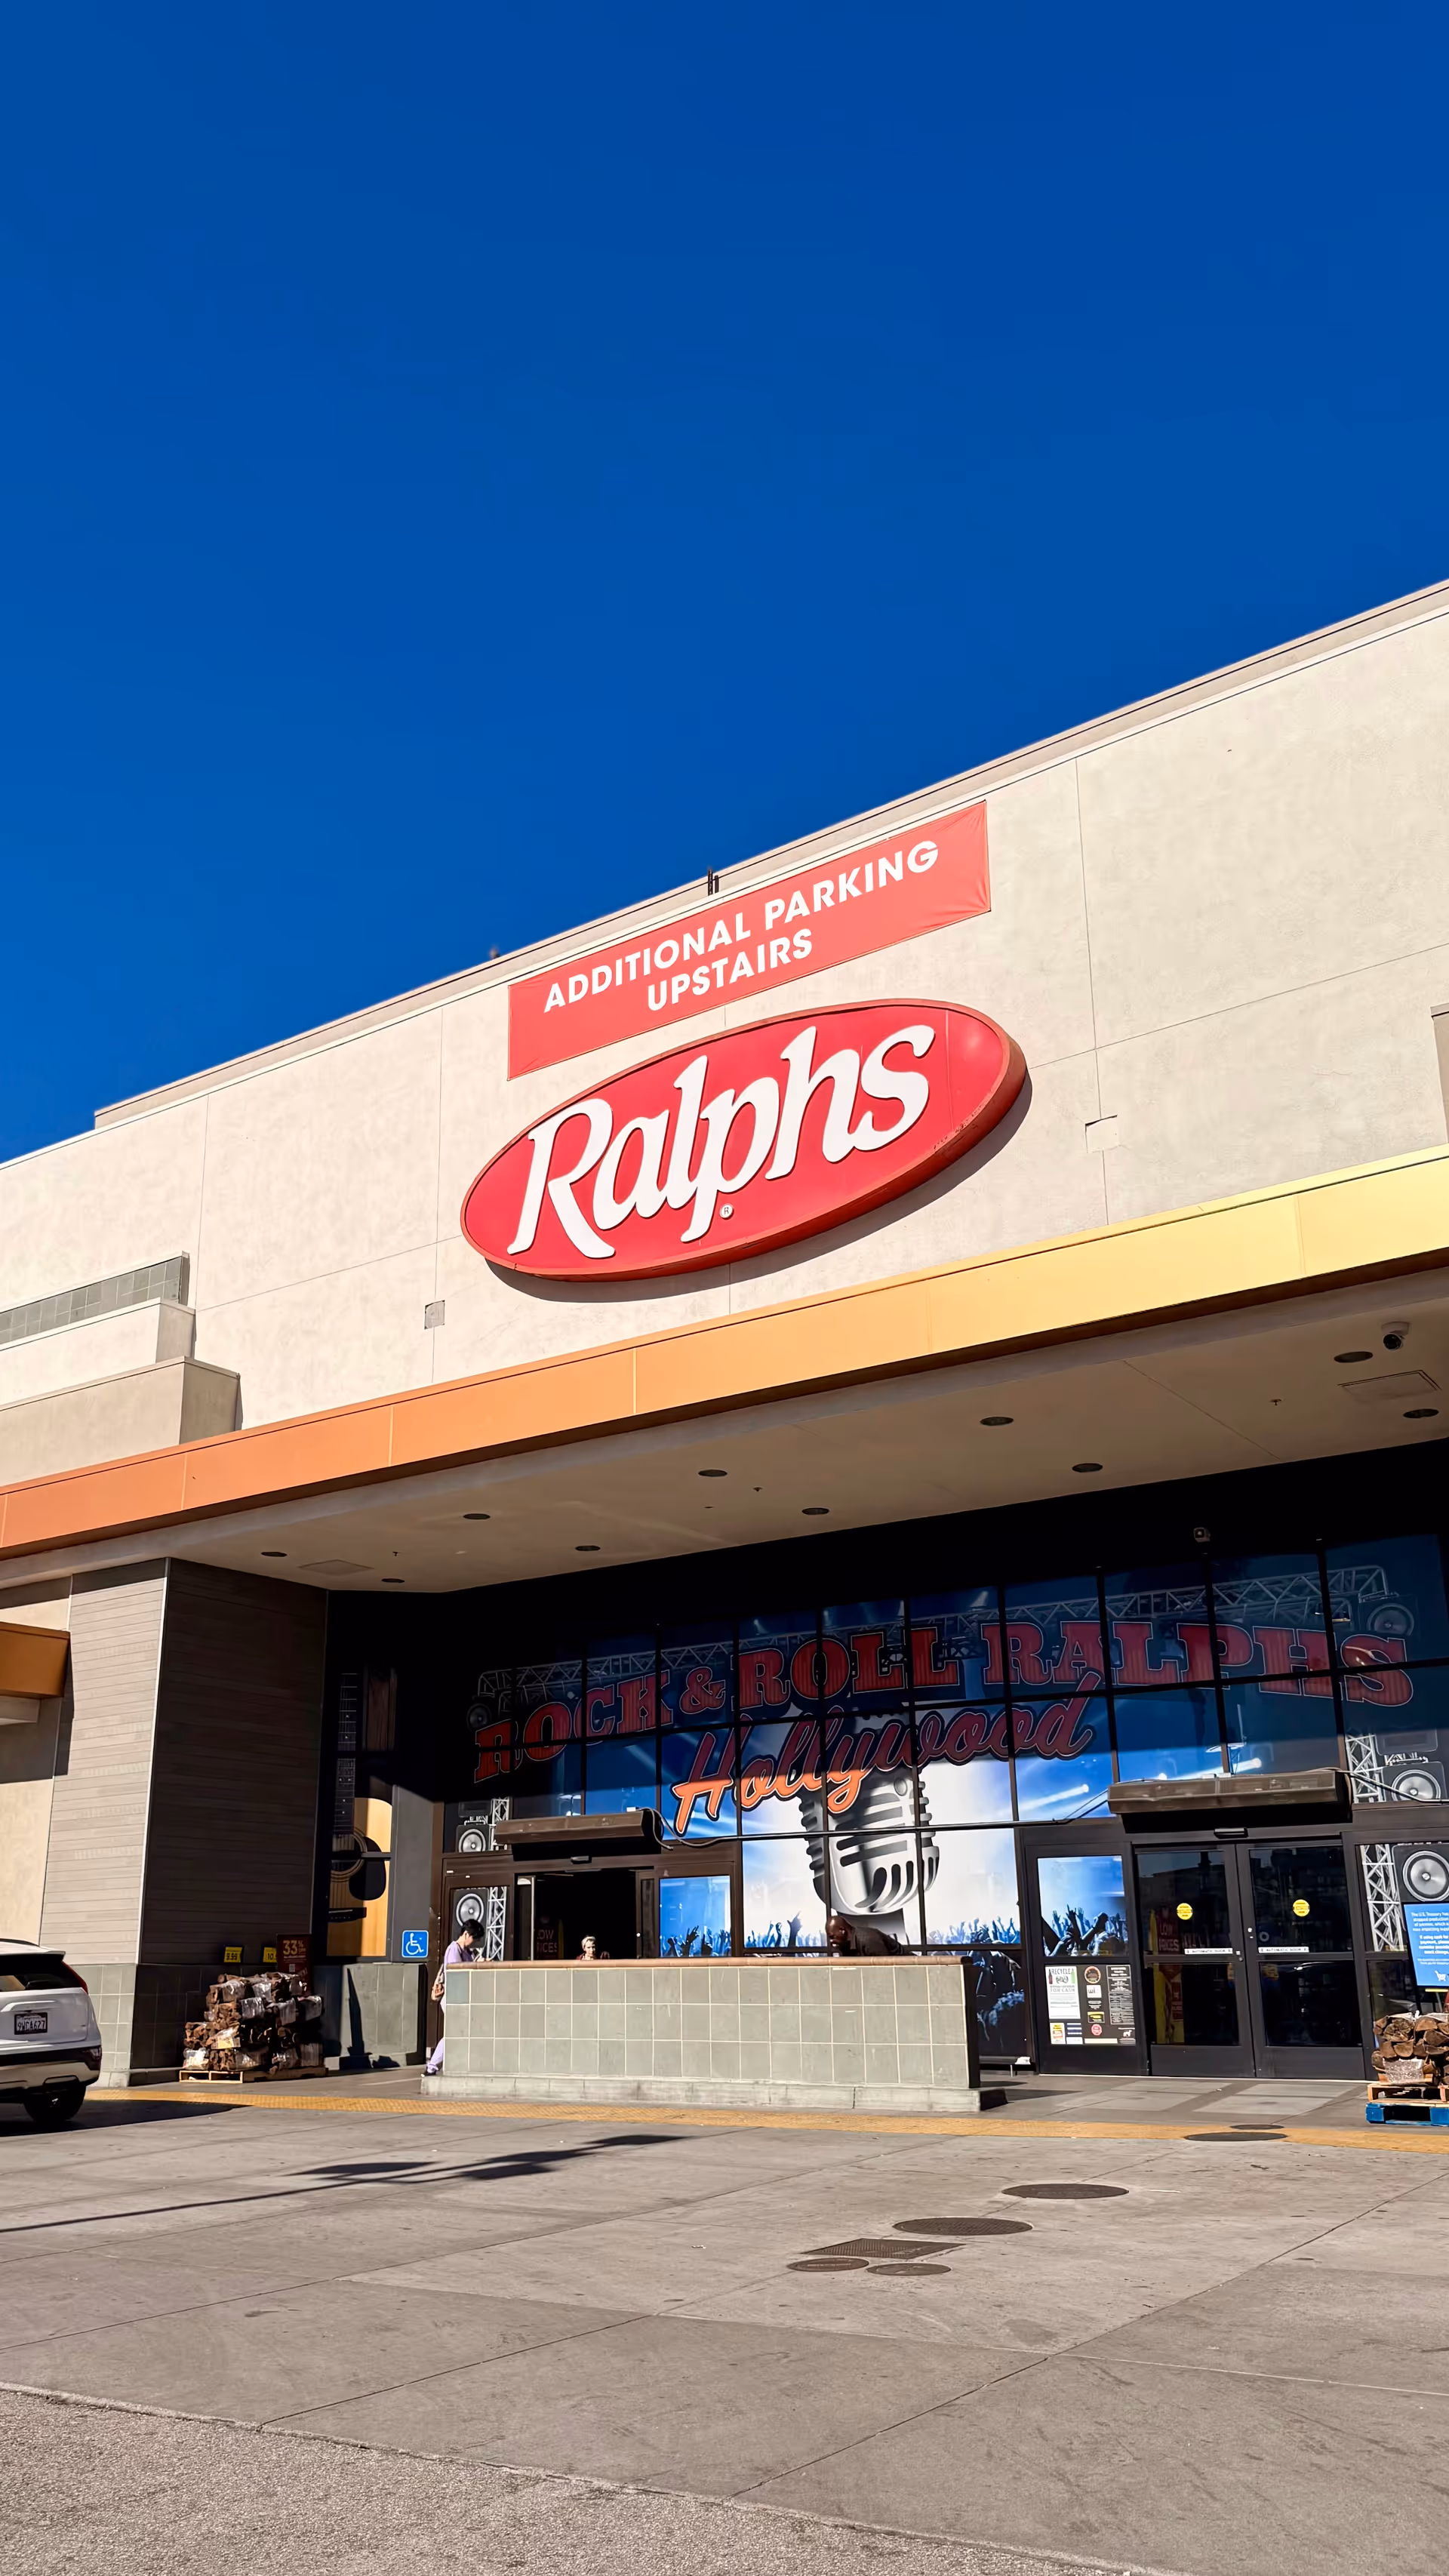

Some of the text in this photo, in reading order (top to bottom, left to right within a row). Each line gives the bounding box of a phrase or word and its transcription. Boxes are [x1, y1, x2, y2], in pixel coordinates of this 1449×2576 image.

[543, 841, 938, 1012] ADDITIONAL PARKING
[648, 929, 813, 1011] UPSTAIRS
[507, 1025, 935, 1258] Ralphs
[474, 1621, 1414, 1784] ROCK & ROLL RALPHS
[672, 1670, 1096, 1836] Hollywood
